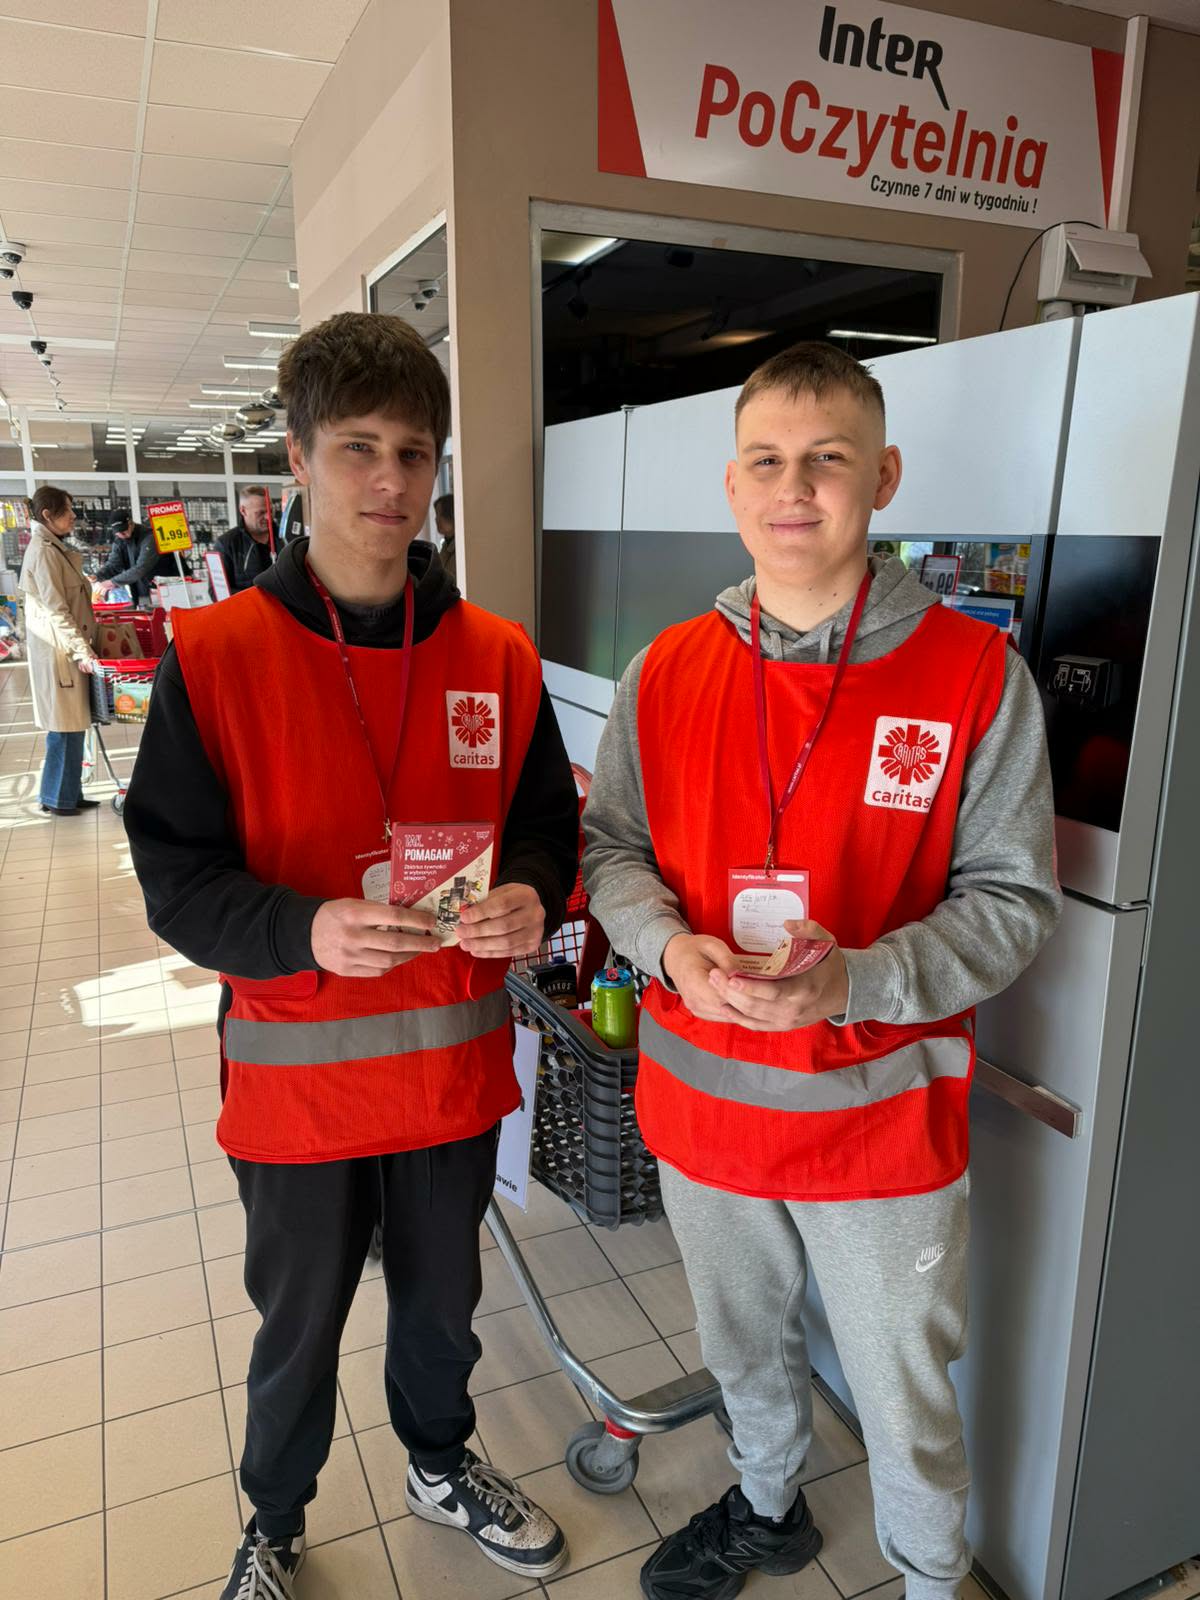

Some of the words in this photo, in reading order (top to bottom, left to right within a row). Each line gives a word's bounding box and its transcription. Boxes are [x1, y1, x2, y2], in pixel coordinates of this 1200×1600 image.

[695, 64, 1048, 189] PoCzytelnia
[870, 174, 921, 198] Czynne
[924, 182, 933, 199] 7
[935, 184, 957, 203] dni
[960, 191, 971, 205] w
[974, 190, 1031, 213] tygodniu
[453, 752, 495, 765] caritas
[872, 789, 932, 809] caritas
[404, 848, 454, 861] POMAGAM!
